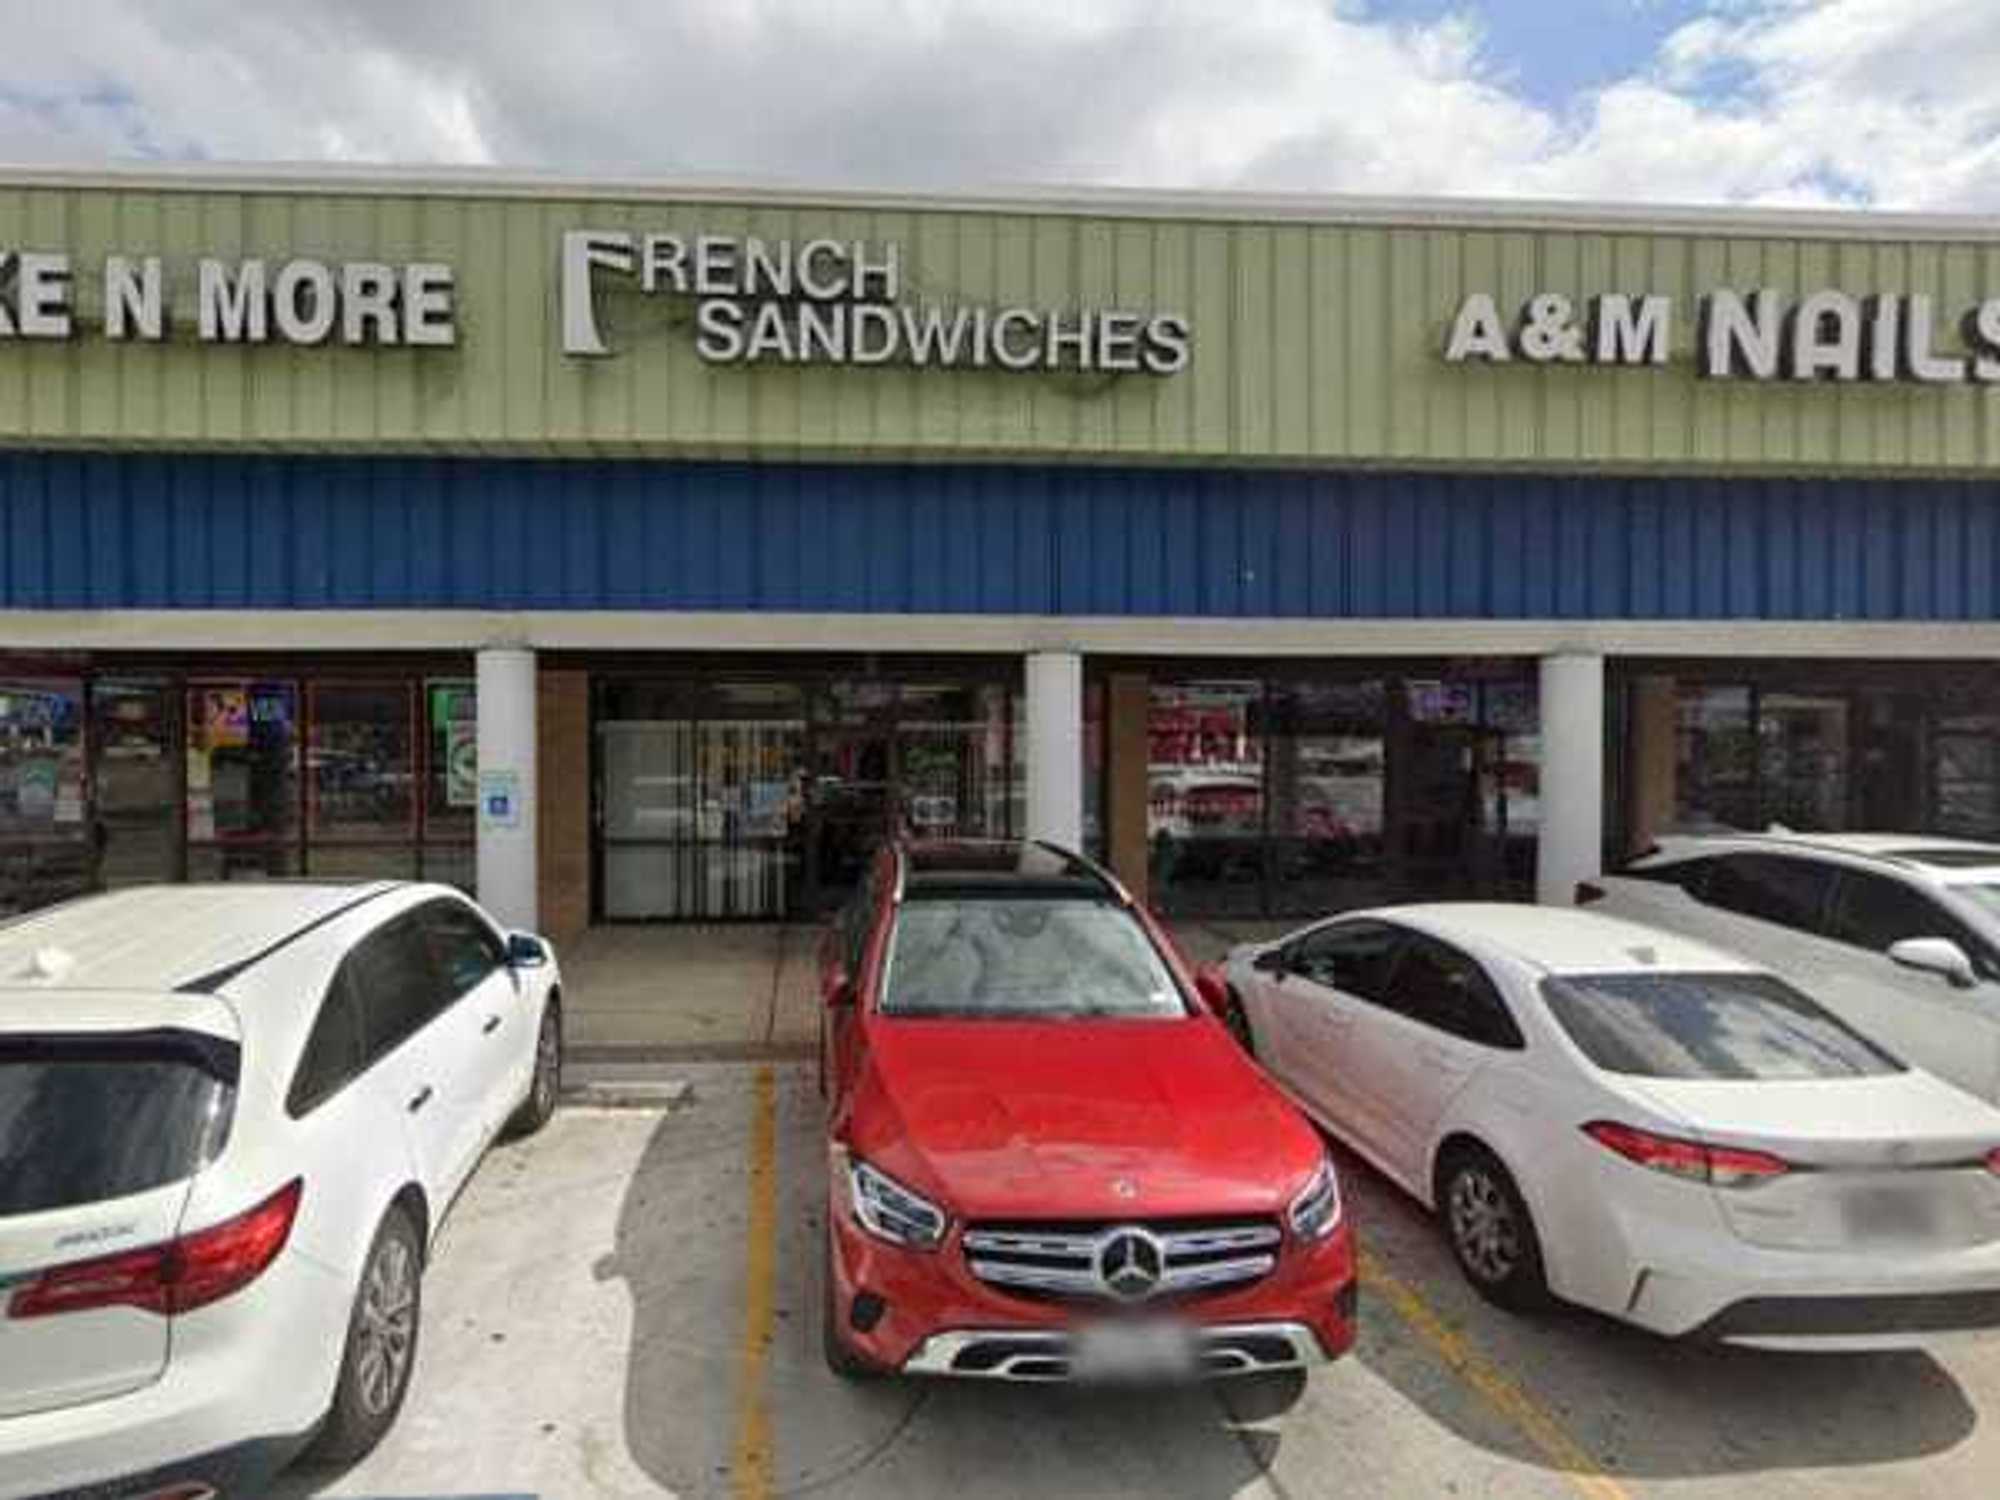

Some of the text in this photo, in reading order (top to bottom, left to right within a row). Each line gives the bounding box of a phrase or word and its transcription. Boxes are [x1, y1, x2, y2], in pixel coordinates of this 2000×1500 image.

[106, 256, 162, 338] N
[199, 259, 455, 344] MORE
[563, 230, 899, 354] FRENCH
[1445, 293, 1669, 361] A&M
[698, 299, 1190, 373] SANDWICHES
